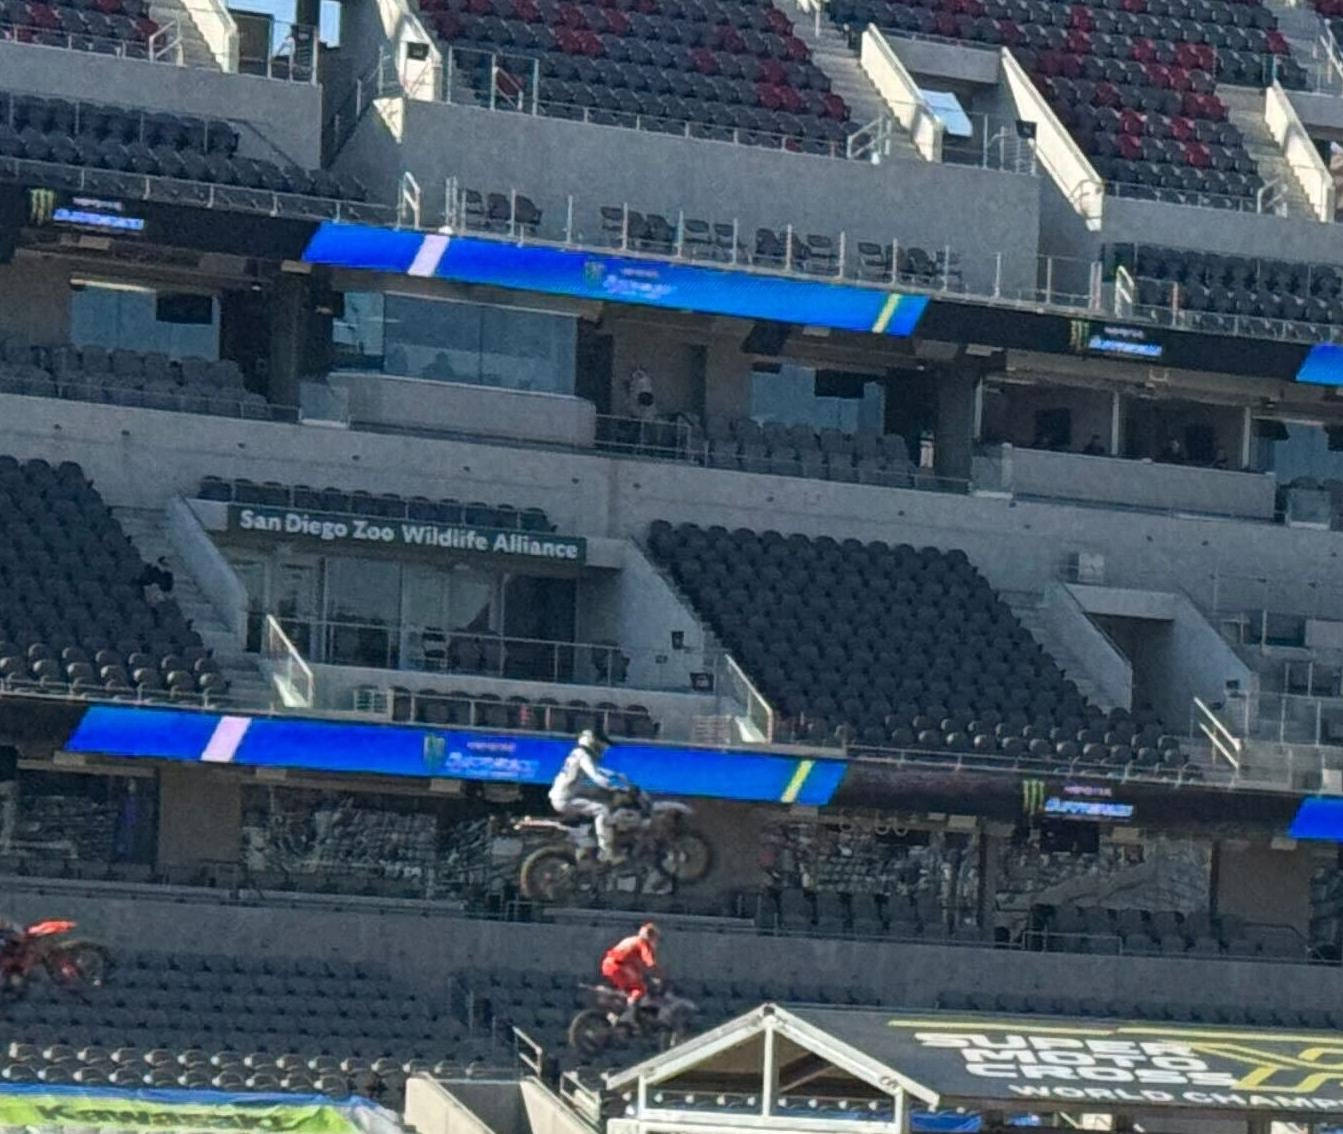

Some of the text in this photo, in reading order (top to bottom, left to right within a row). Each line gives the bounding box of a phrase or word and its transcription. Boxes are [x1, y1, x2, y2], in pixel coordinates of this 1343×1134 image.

[240, 510, 578, 560] San Diego Zoo Wildlife Alliance
[915, 1033, 1203, 1056] SUPER
[961, 1048, 1208, 1072] MOTO
[966, 1062, 1239, 1088] CROSS
[1007, 1083, 1171, 1102] WORLD
